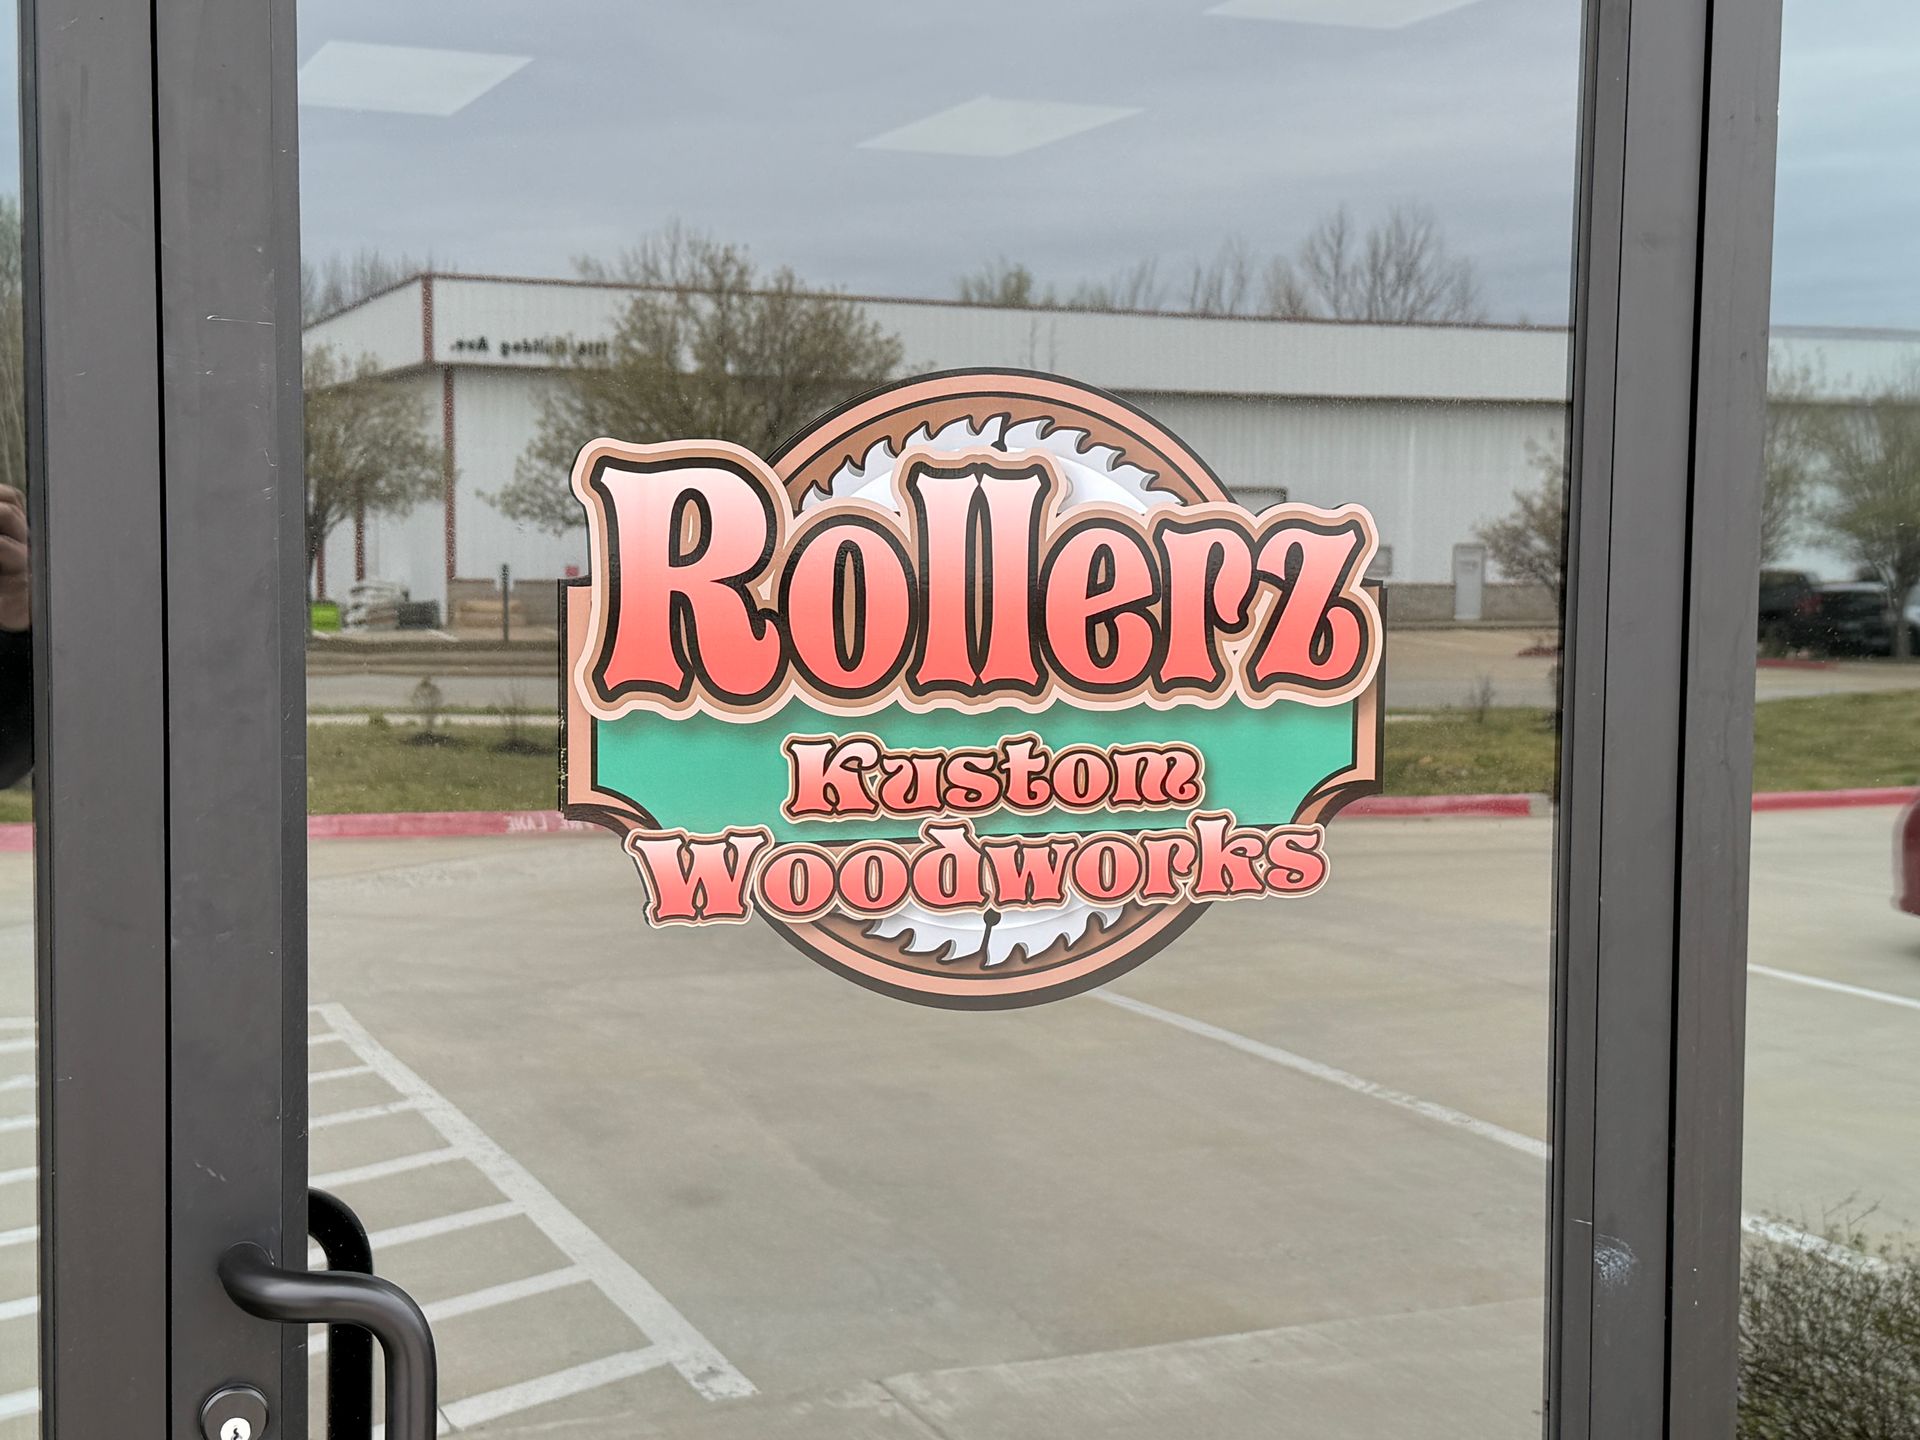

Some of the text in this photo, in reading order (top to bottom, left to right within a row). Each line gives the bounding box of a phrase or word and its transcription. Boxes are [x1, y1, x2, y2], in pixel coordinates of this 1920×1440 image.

[590, 455, 1368, 704] Rollerz
[786, 736, 1200, 817] Kustom
[630, 814, 1327, 922] Woodworks
